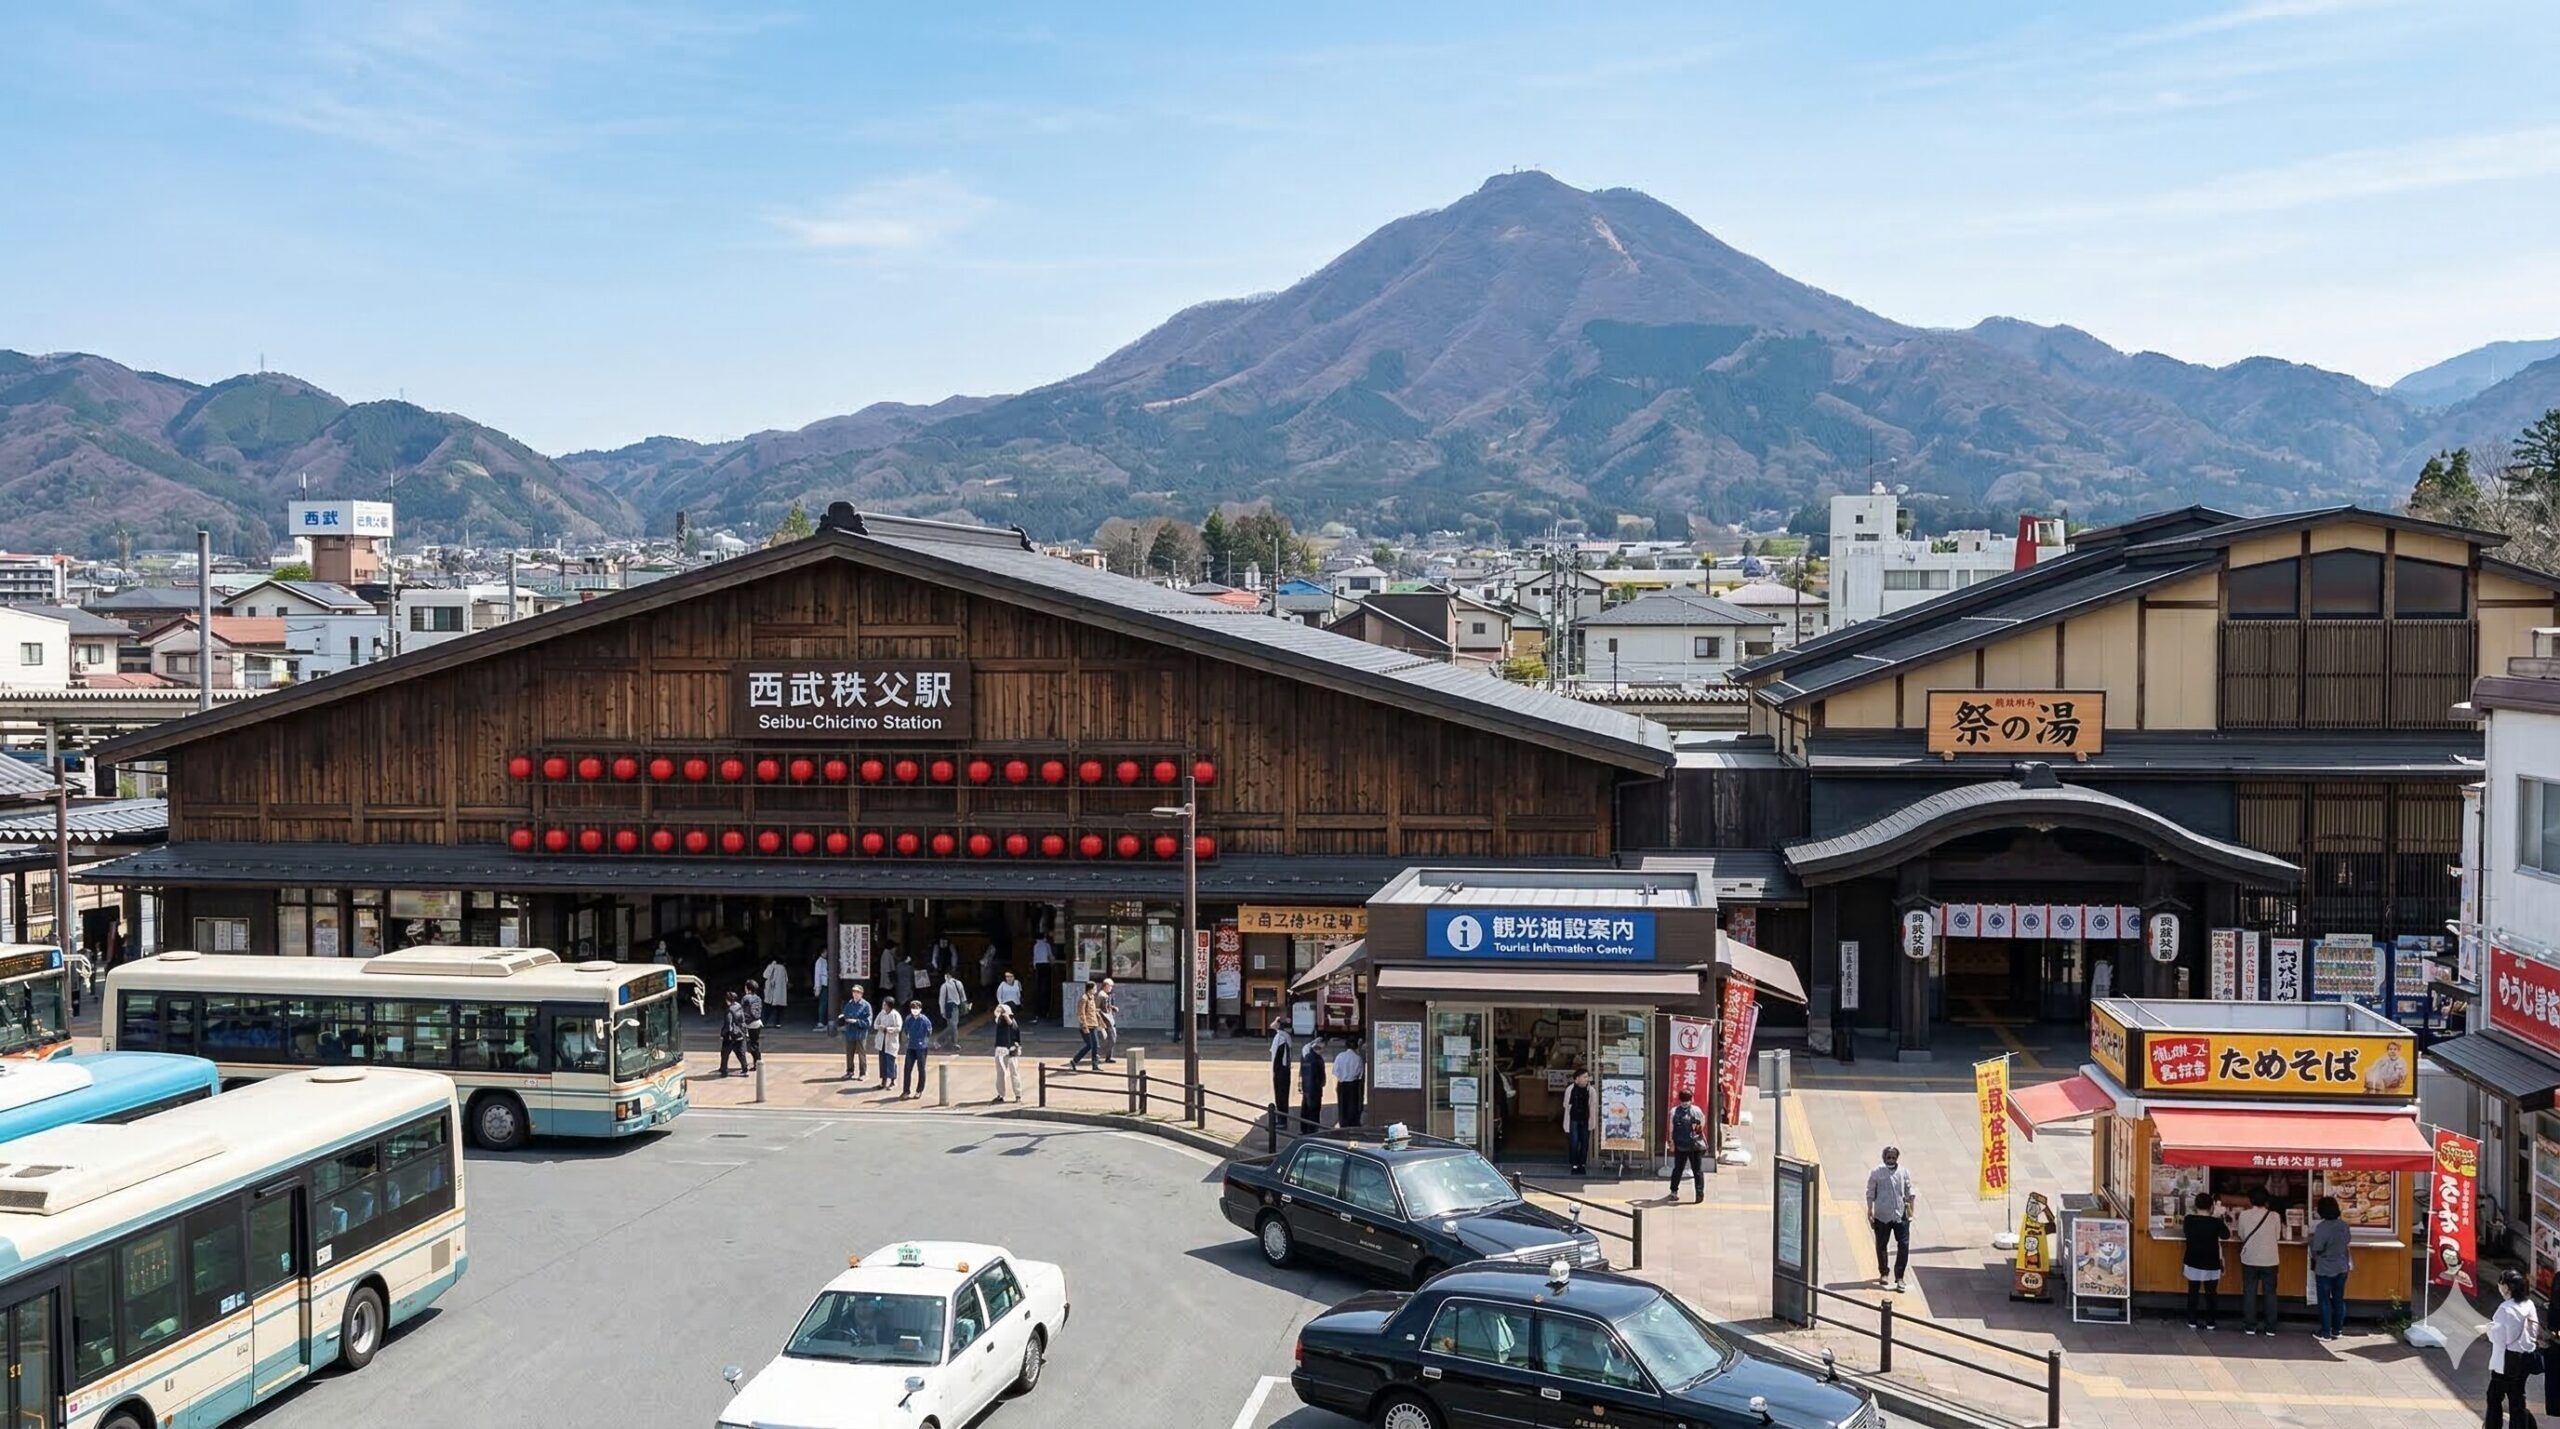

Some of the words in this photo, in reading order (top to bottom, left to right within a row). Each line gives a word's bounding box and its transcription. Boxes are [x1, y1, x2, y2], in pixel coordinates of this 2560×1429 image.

[304, 510, 338, 525] 西武
[749, 671, 952, 708] 西武秩父駅
[883, 714, 942, 730] Station
[1950, 701, 2081, 747] 祭の湯
[2219, 1047, 2360, 1082] ためそば
